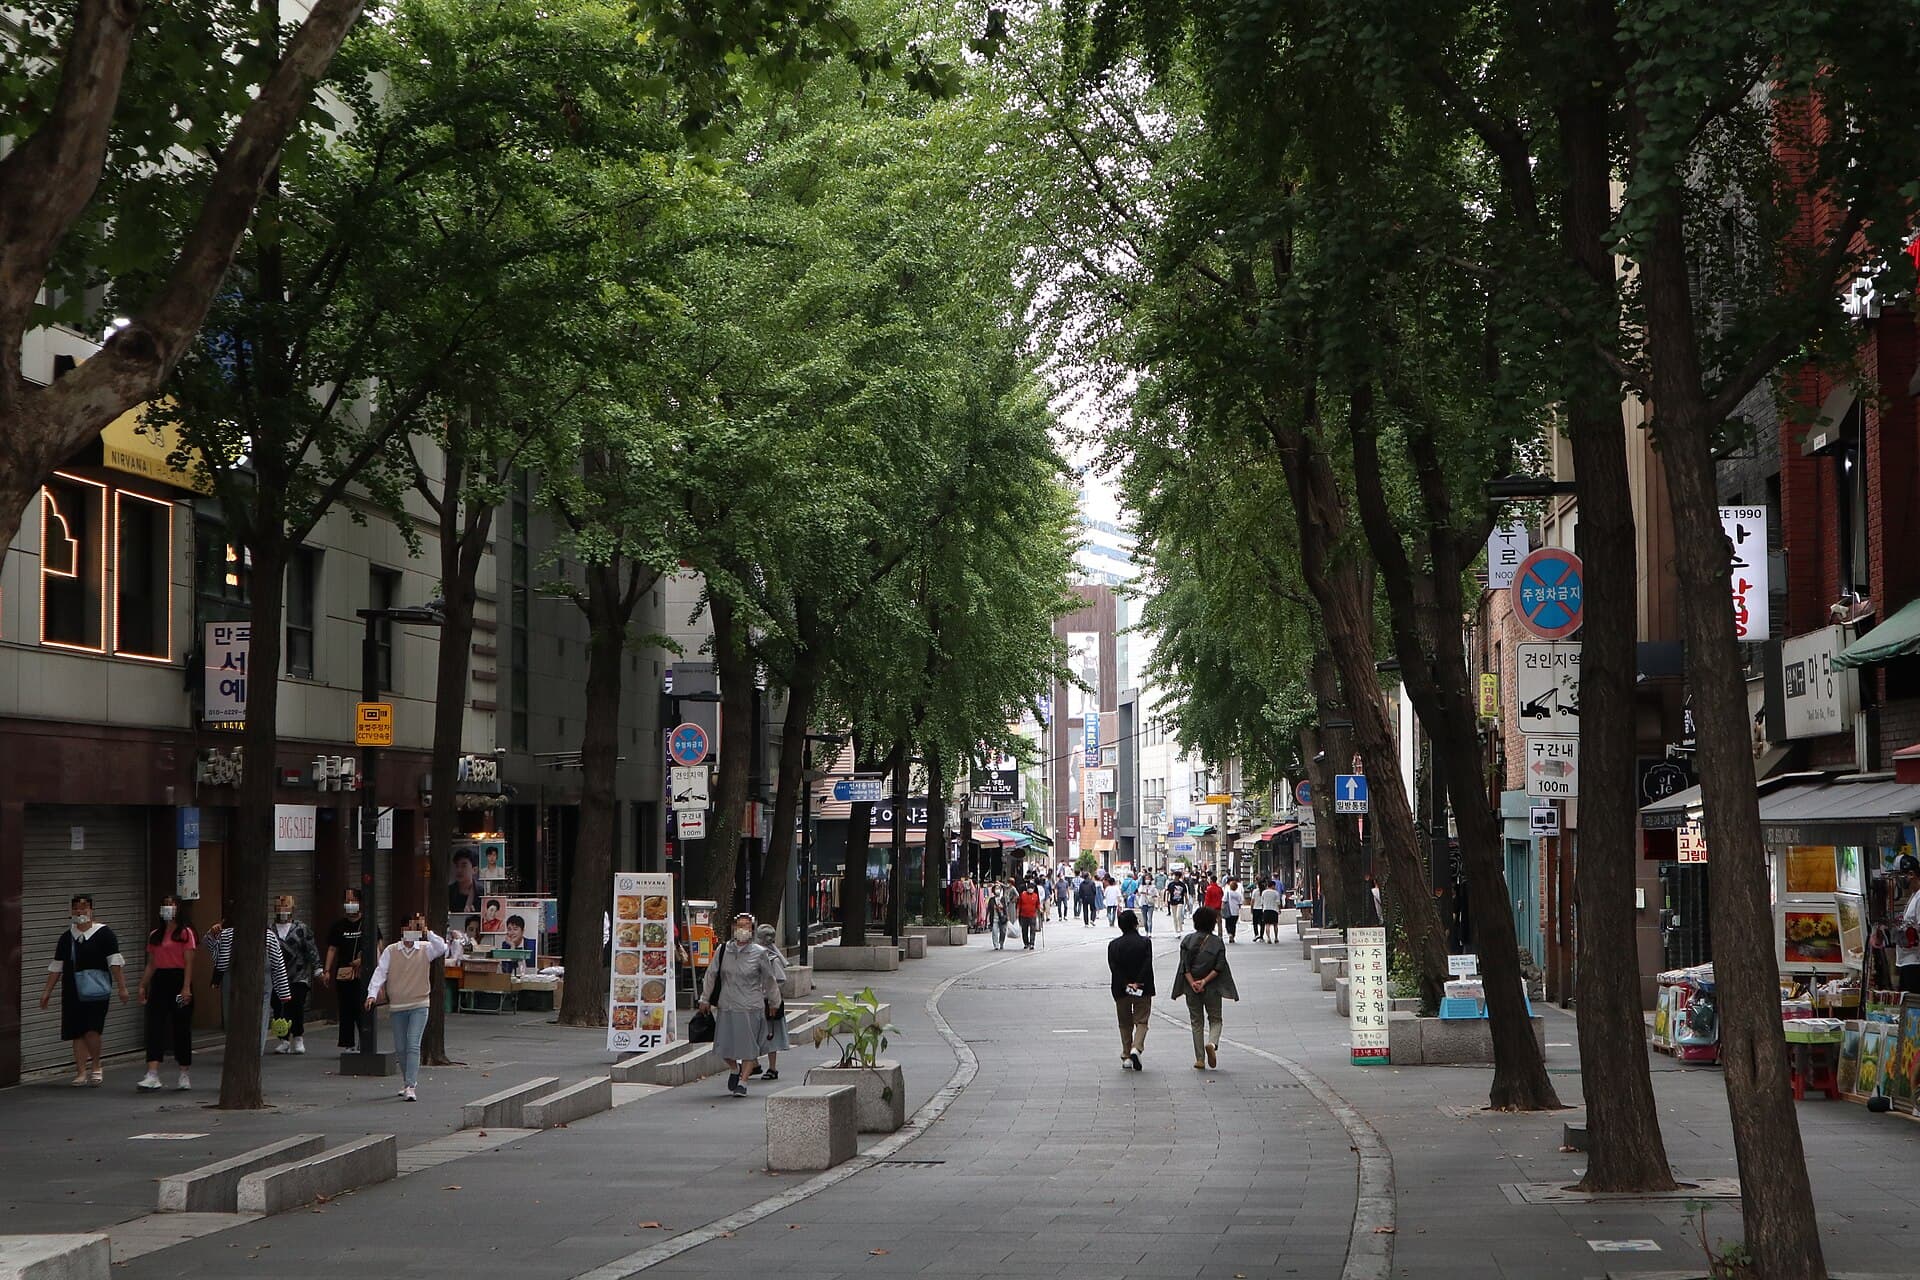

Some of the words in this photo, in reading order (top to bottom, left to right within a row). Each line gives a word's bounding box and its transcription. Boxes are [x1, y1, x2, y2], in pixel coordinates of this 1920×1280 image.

[111, 451, 147, 472] NIRVANA
[1734, 509, 1762, 519] 1990
[1523, 586, 1580, 602] 주정차금지
[1533, 743, 1573, 758] 구간내
[675, 771, 704, 780] 견인지역
[1538, 780, 1569, 793] 100m
[1337, 801, 1366, 811] 일방통행
[279, 816, 292, 838] BIG
[293, 816, 313, 838] SALE
[639, 1034, 662, 1048] 2F
